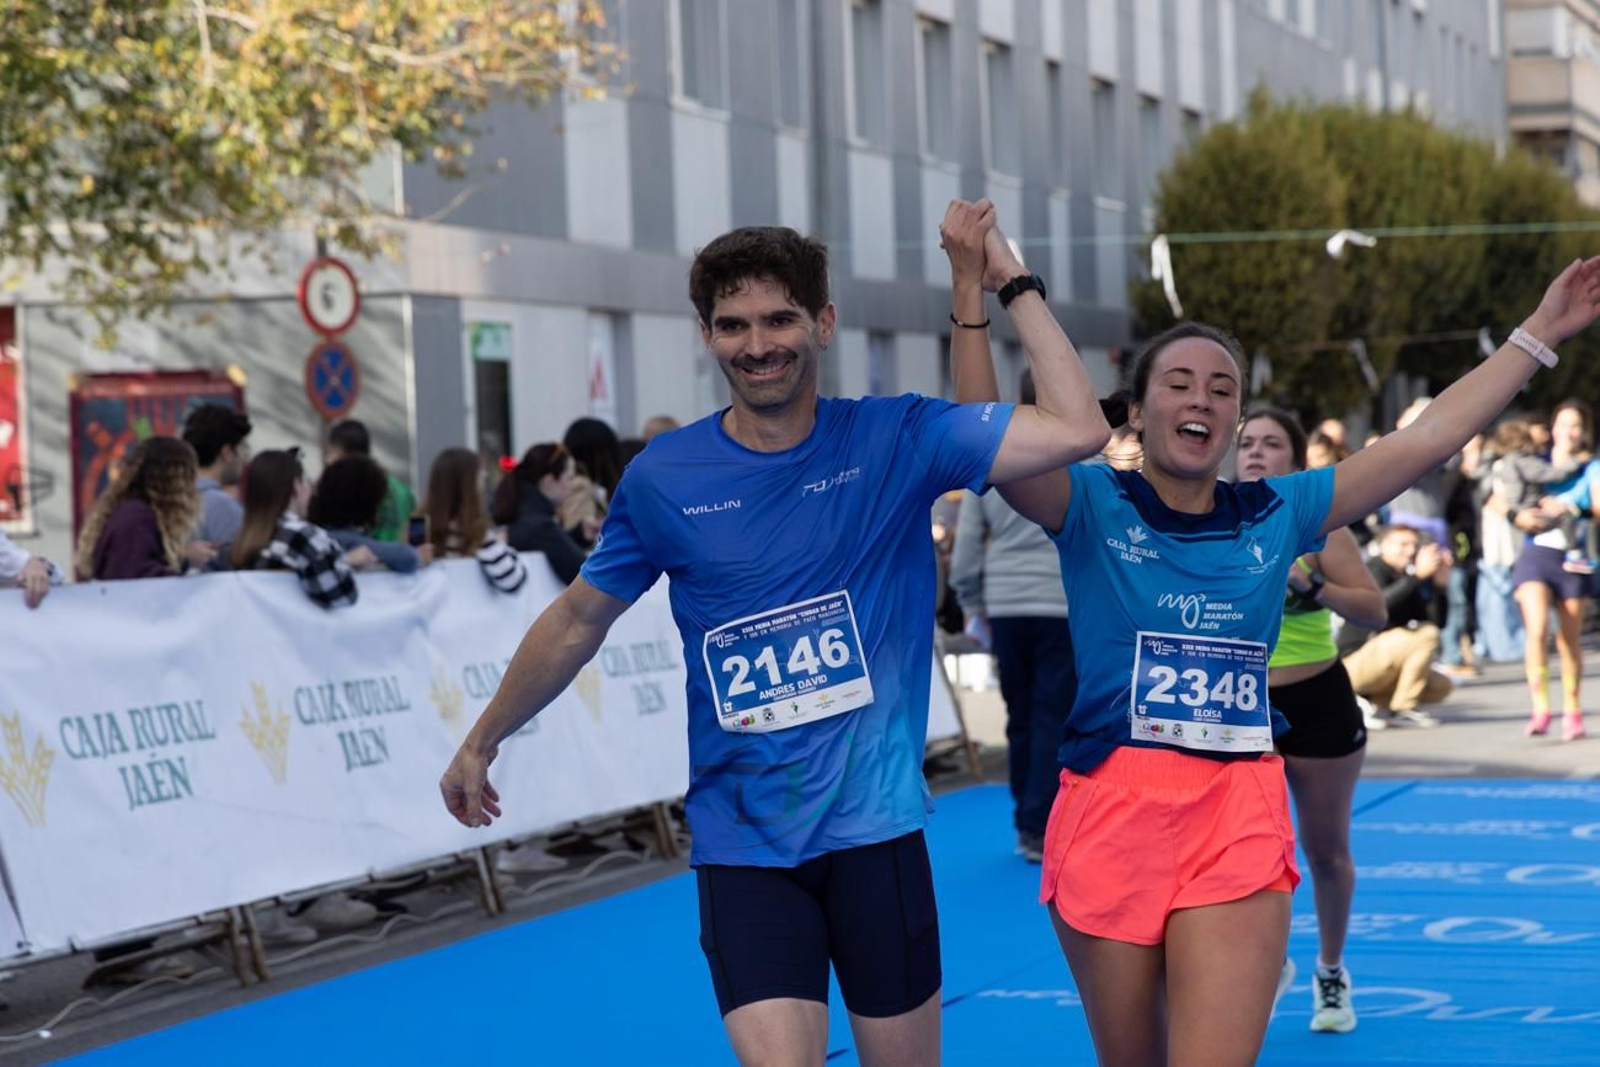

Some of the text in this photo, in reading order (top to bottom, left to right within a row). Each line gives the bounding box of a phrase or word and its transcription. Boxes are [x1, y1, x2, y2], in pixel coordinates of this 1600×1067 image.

[682, 499, 741, 515] WILLIN
[1106, 538, 1160, 560] CAJA RURAL
[1203, 612, 1243, 621] MARATÓN
[1205, 602, 1233, 611] MEDIA
[1199, 621, 1220, 630] JAÉN
[722, 628, 850, 697] 2146
[293, 676, 411, 725] CAJA RURAL
[758, 684, 796, 701] ANDRES
[796, 674, 828, 690] DAVID
[1145, 665, 1258, 711] 2348
[1193, 708, 1223, 719] ELOÍSA
[59, 699, 217, 759] CAJA RURAL
[336, 721, 390, 773] JAÉN
[118, 752, 193, 811] JAÉN
